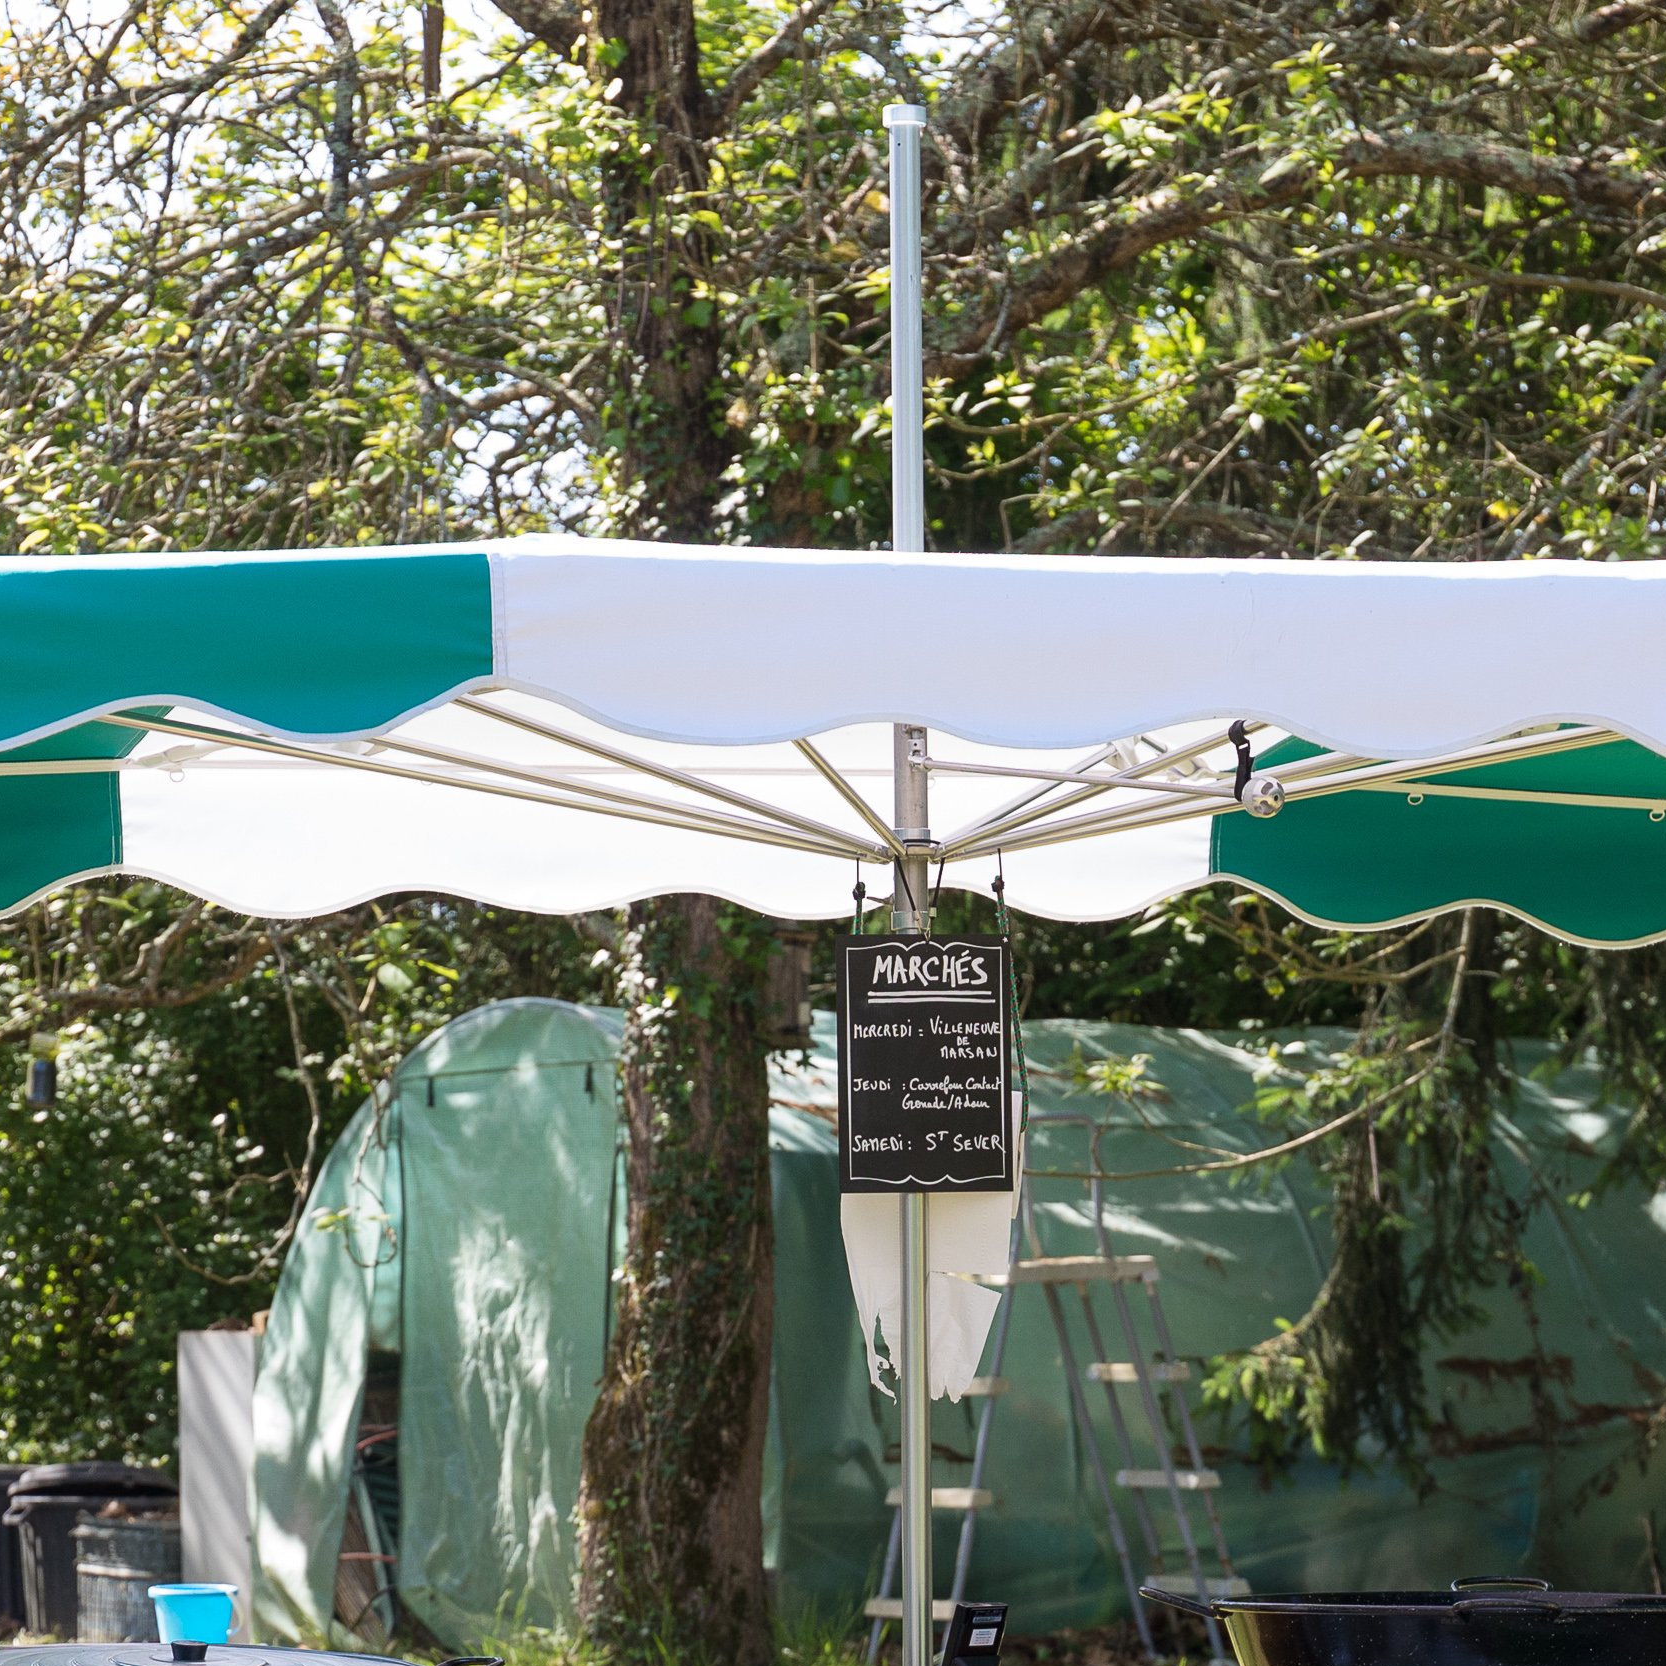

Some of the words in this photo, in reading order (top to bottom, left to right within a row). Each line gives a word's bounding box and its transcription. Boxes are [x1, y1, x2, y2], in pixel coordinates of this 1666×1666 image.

[873, 950, 987, 987] MARCHÉS
[957, 1036, 969, 1046] DE
[965, 1076, 1001, 1090] Contact
